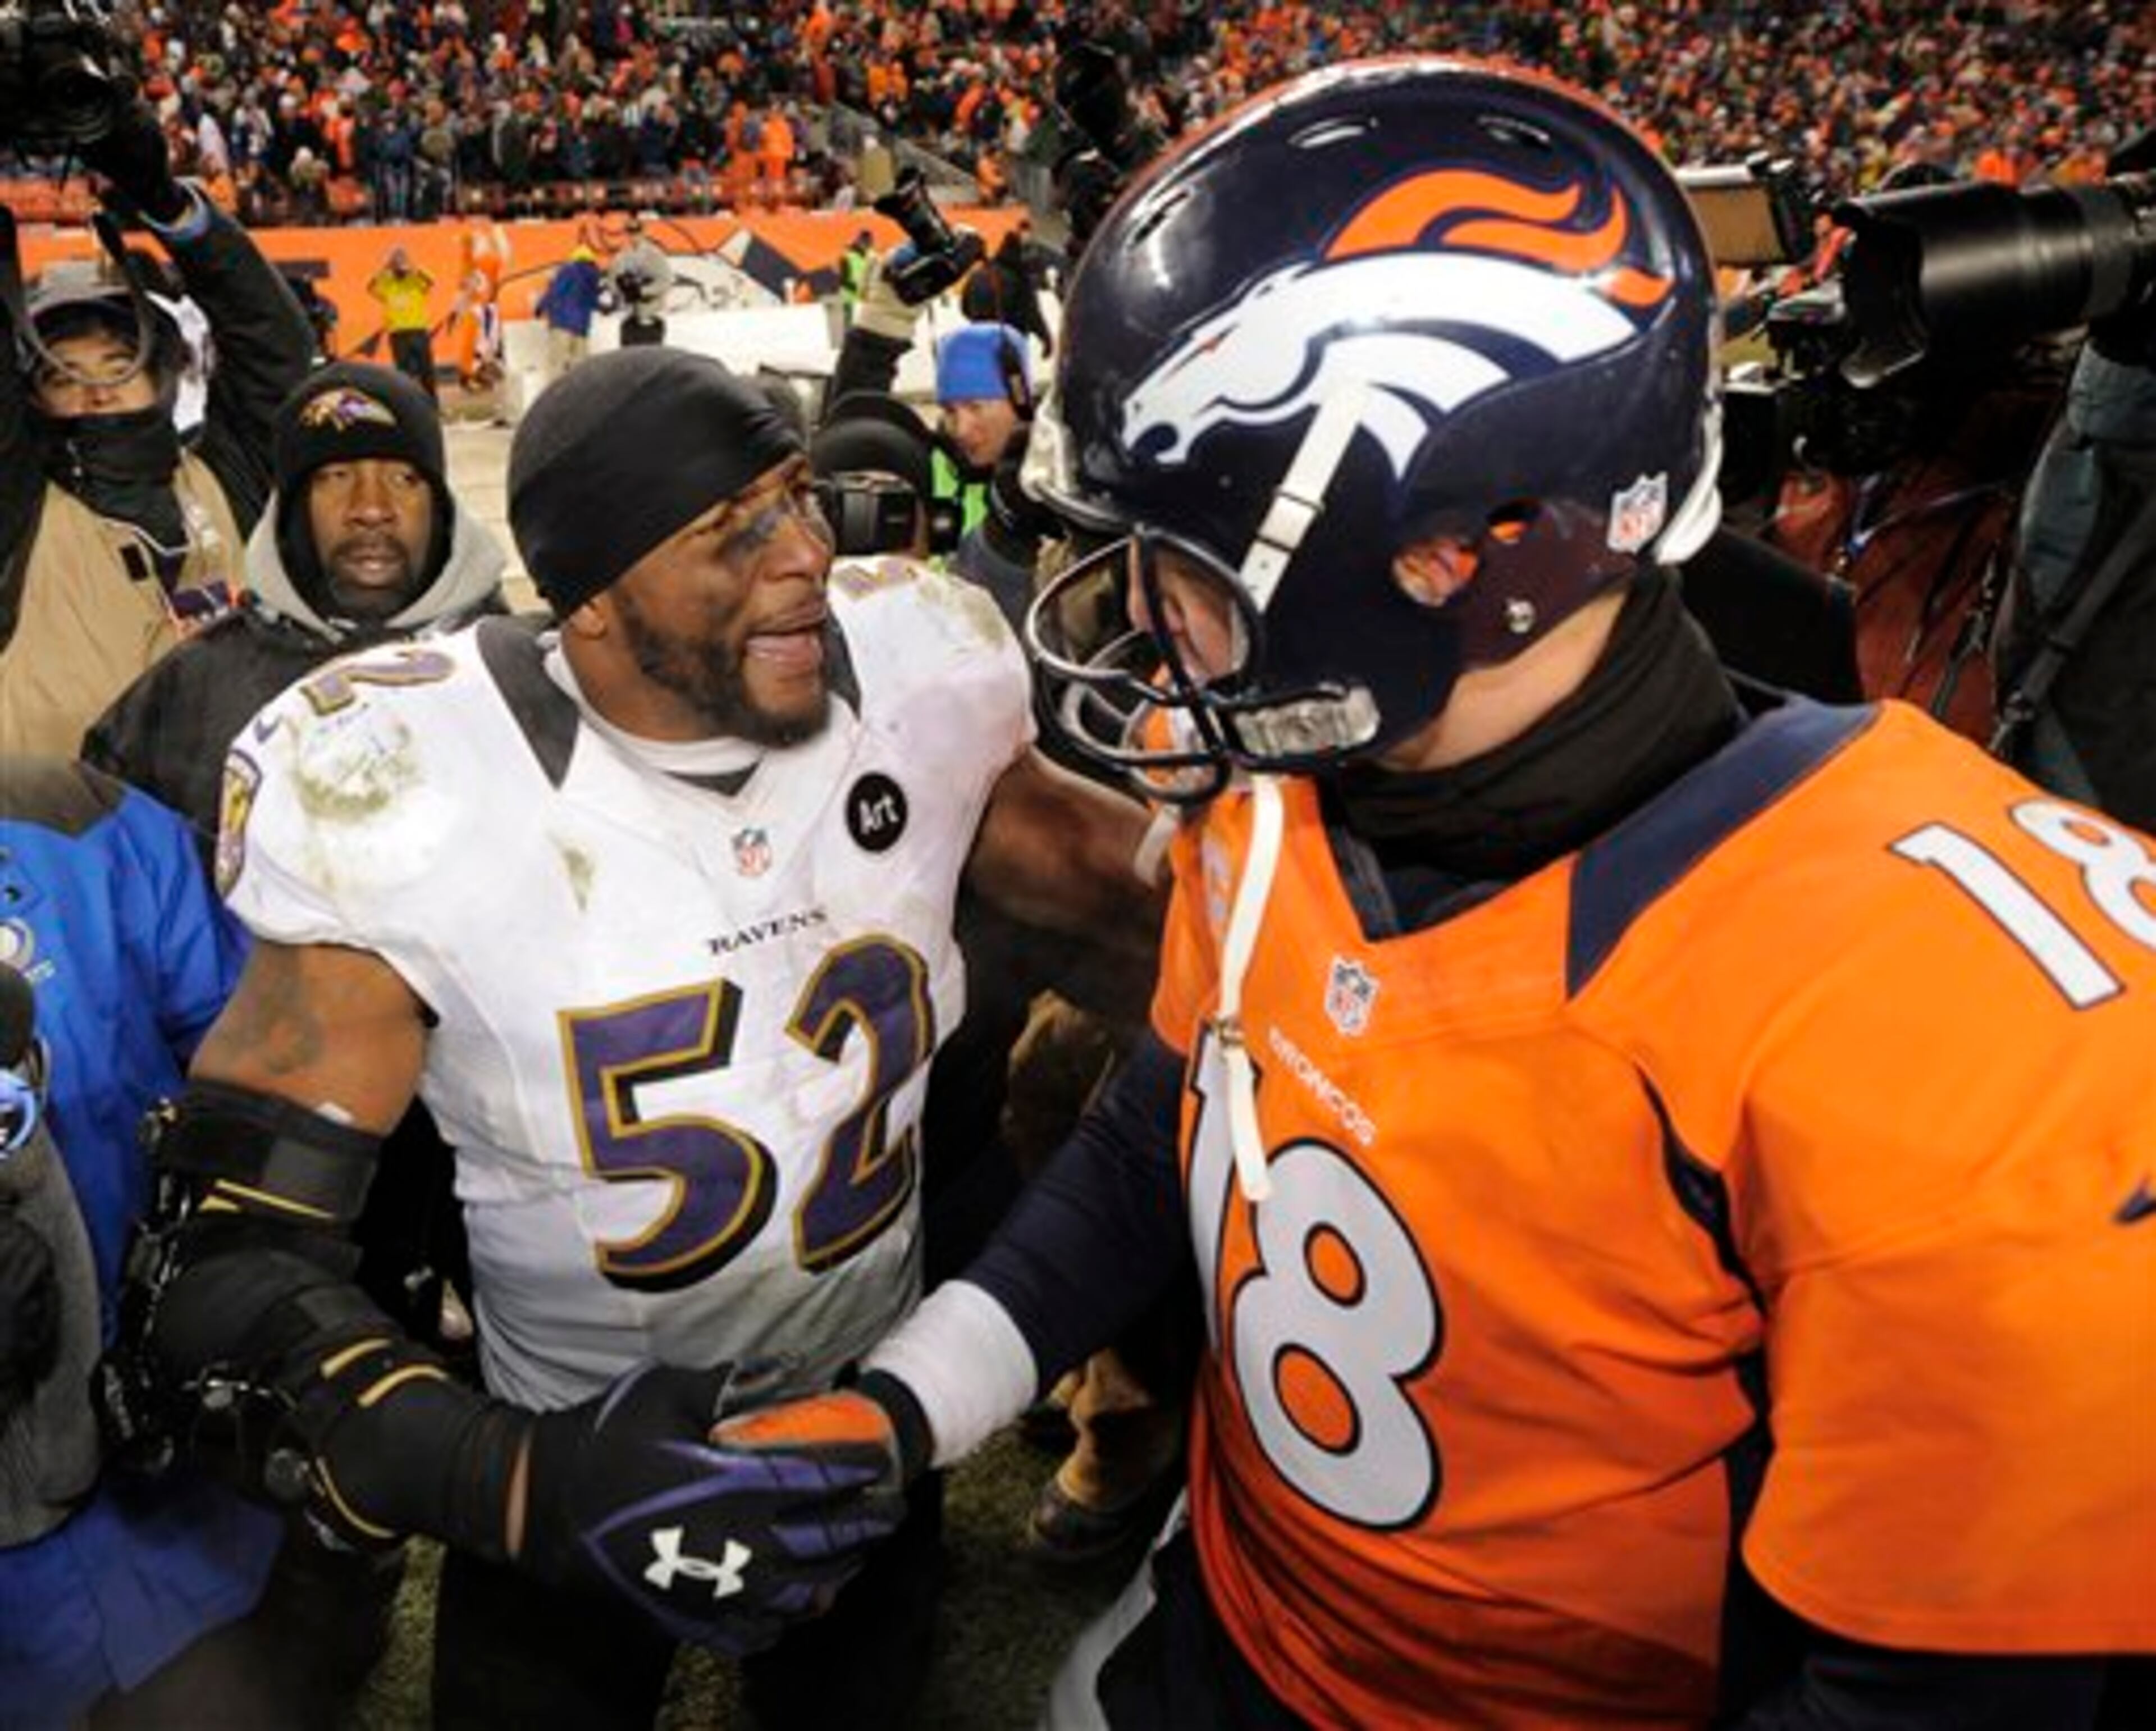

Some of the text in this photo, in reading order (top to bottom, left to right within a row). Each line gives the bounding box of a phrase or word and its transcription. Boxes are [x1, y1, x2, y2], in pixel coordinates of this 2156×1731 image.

[860, 793, 900, 835] Art
[707, 905, 828, 955] RAVENS
[1884, 795, 2156, 1011] 18
[557, 932, 937, 1292] 52
[1268, 1025, 1378, 1147] BRONCOS
[1188, 1017, 1444, 1533] 18
